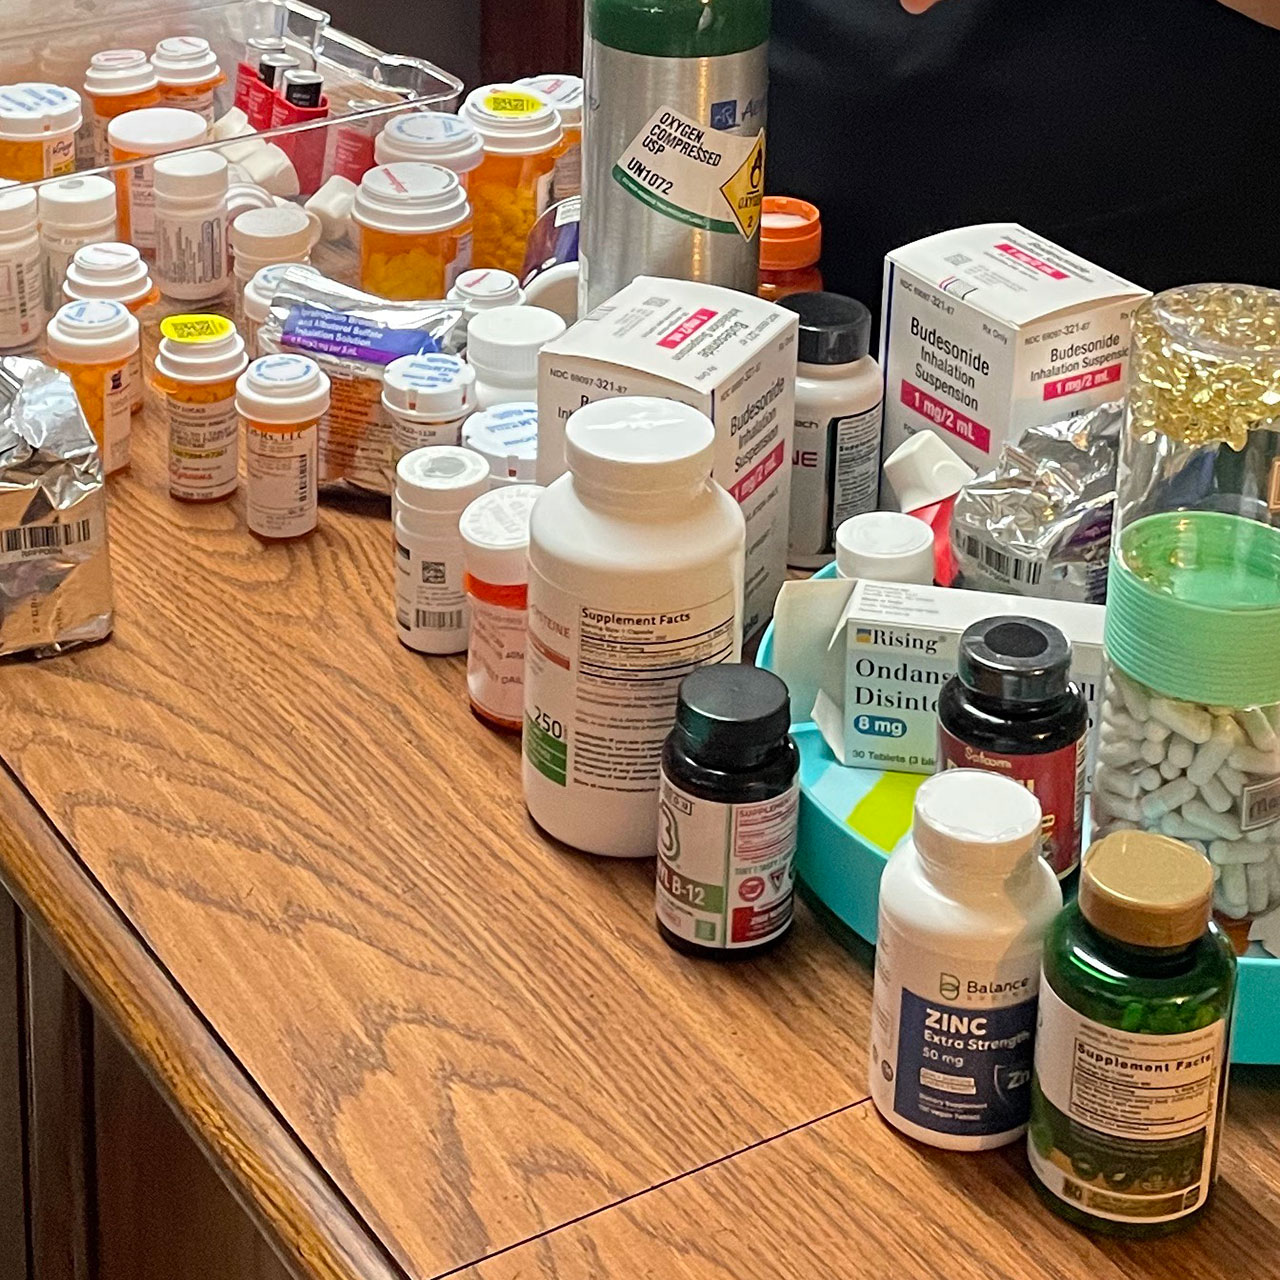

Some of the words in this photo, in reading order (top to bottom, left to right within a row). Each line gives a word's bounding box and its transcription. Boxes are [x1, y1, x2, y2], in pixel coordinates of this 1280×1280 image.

[659, 112, 705, 145] OXYGEN,
[642, 136, 666, 155] USP
[650, 124, 722, 167] COMPRESSED
[627, 157, 674, 196] UN1072
[747, 215, 753, 229] 2
[295, 326, 334, 340] Inhalation
[336, 333, 371, 346] Solution
[910, 316, 990, 376] Budesonide
[993, 326, 1008, 344] Only
[1050, 333, 1120, 363] Budesonide
[549, 368, 569, 381] NDC
[920, 346, 975, 389] Inhalation
[1030, 359, 1079, 382] Inhalation
[915, 362, 979, 412] Suspension
[1055, 383, 1061, 394] 1
[1062, 373, 1091, 392] mg/2
[1094, 370, 1110, 383] mL
[730, 375, 786, 437] Budesonide
[913, 391, 920, 408] 1
[923, 395, 954, 428] mg/2
[956, 417, 975, 441] mL
[738, 406, 777, 449] Inhalation
[734, 425, 779, 473] Suspension
[582, 607, 656, 626] Supplement
[659, 612, 691, 626] Facts
[872, 629, 938, 655] Rising
[533, 705, 563, 738] 250
[858, 715, 870, 731] 8
[875, 720, 904, 737] mg
[852, 750, 865, 760] 30
[868, 751, 905, 764] Tablets
[908, 754, 918, 766] (3
[672, 877, 706, 906] B-12
[967, 977, 1030, 994] Balance
[925, 1008, 987, 1035] ZINC
[924, 1029, 964, 1050] Extra
[967, 1030, 1031, 1051] Strength
[922, 1046, 938, 1061] 50
[941, 1053, 964, 1068] mg
[1078, 1043, 1170, 1073] Supplement
